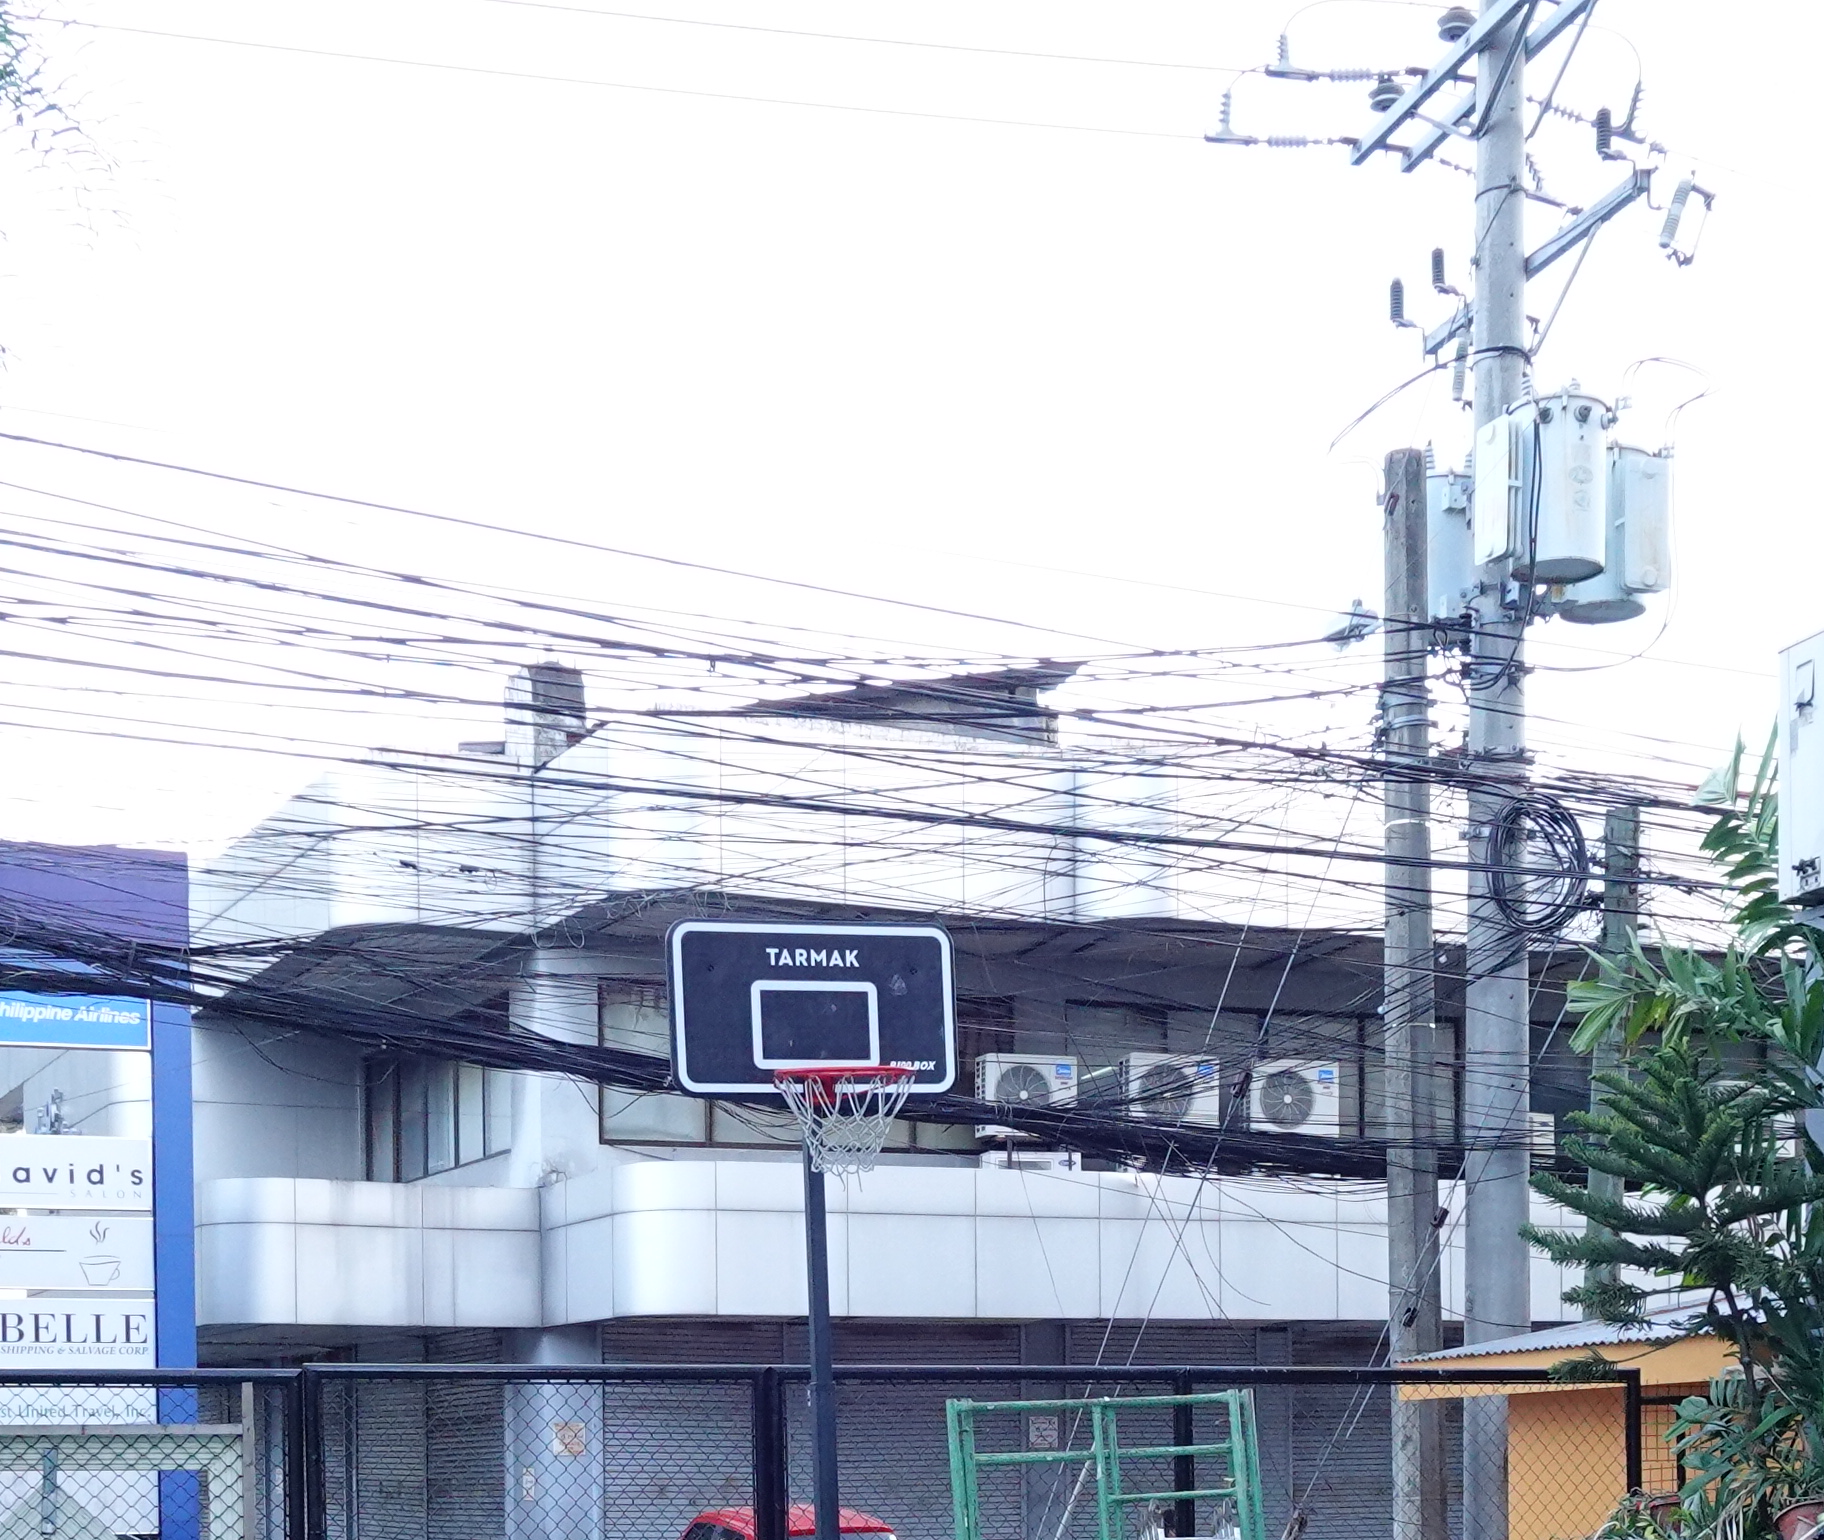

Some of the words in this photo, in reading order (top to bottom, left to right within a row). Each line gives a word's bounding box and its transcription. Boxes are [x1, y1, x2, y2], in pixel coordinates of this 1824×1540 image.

[765, 947, 860, 968] TARMAK
[74, 1005, 141, 1025] Airlines
[914, 1060, 936, 1071] BOX
[69, 1189, 143, 1199] SALON
[0, 1346, 55, 1355] SHIPPING
[57, 1346, 66, 1355] &
[67, 1346, 117, 1356] SALVAGE
[18, 1404, 66, 1419] United
